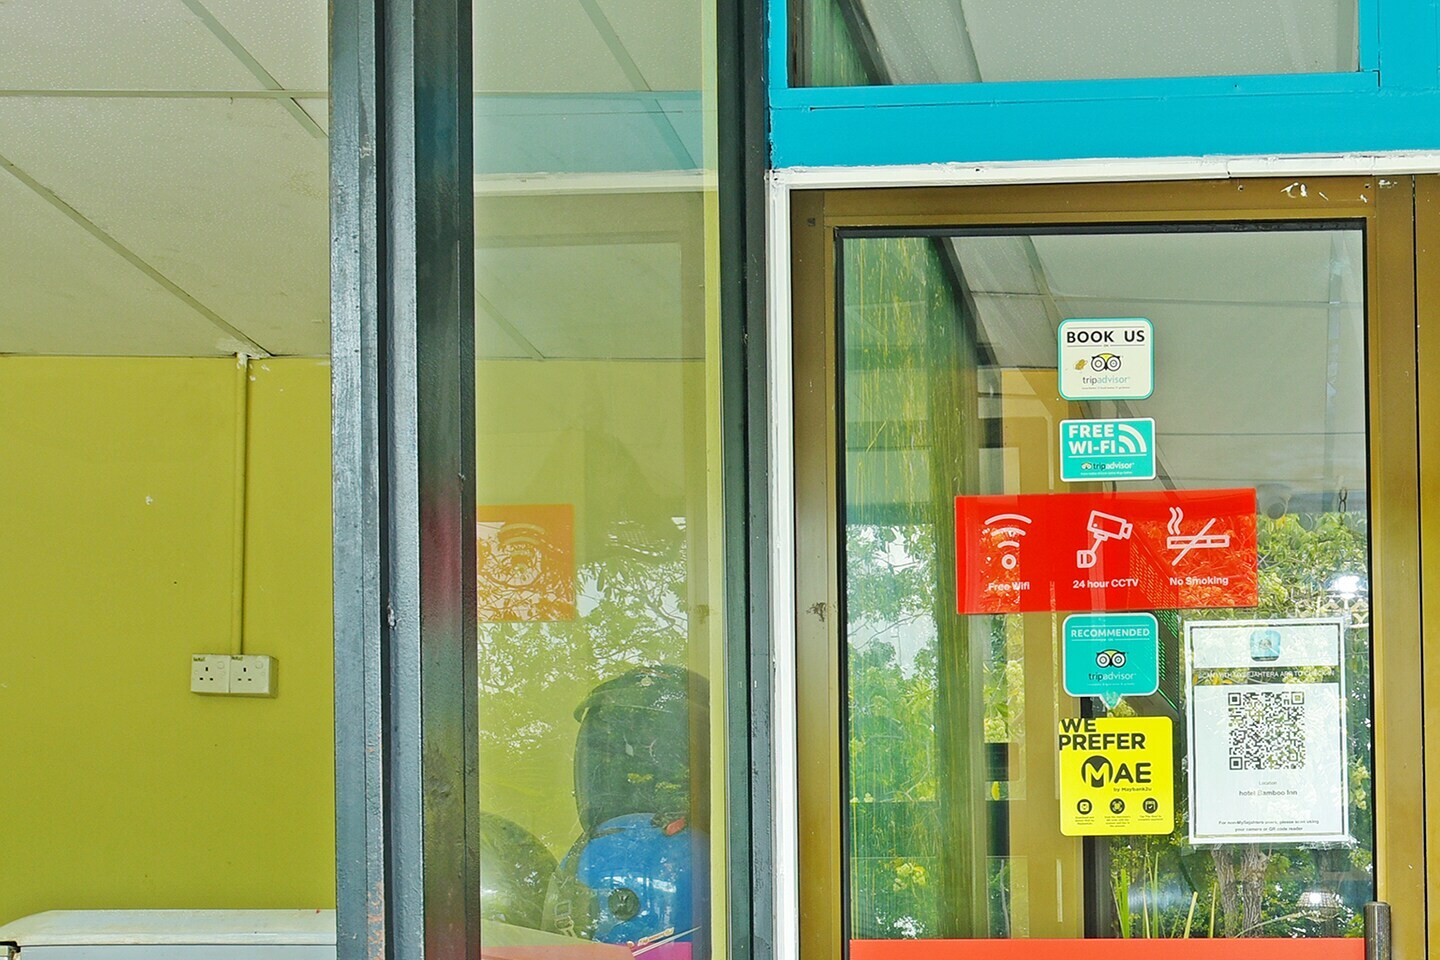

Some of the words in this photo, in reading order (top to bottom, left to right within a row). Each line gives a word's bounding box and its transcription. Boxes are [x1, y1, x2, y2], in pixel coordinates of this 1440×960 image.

[1066, 330, 1115, 343] BOOK
[1124, 330, 1145, 342] US
[1082, 375, 1128, 385] tripadvisor
[1069, 424, 1115, 438] FREE
[1068, 440, 1116, 454] WI-FI
[1093, 461, 1133, 471] tripadvisor
[988, 582, 1011, 590] Free
[1012, 581, 1030, 590] Wifi
[1072, 580, 1086, 589] 24
[1088, 579, 1111, 588] hour
[1111, 578, 1139, 588] CCTV
[1170, 577, 1184, 586] No
[1186, 575, 1229, 587] Smoking
[1071, 628, 1150, 638] RECOMMENDED
[1088, 671, 1134, 681] tripadvisor
[1061, 718, 1097, 733] WE
[1058, 733, 1146, 751] PREFER
[1081, 755, 1152, 788] MAE
